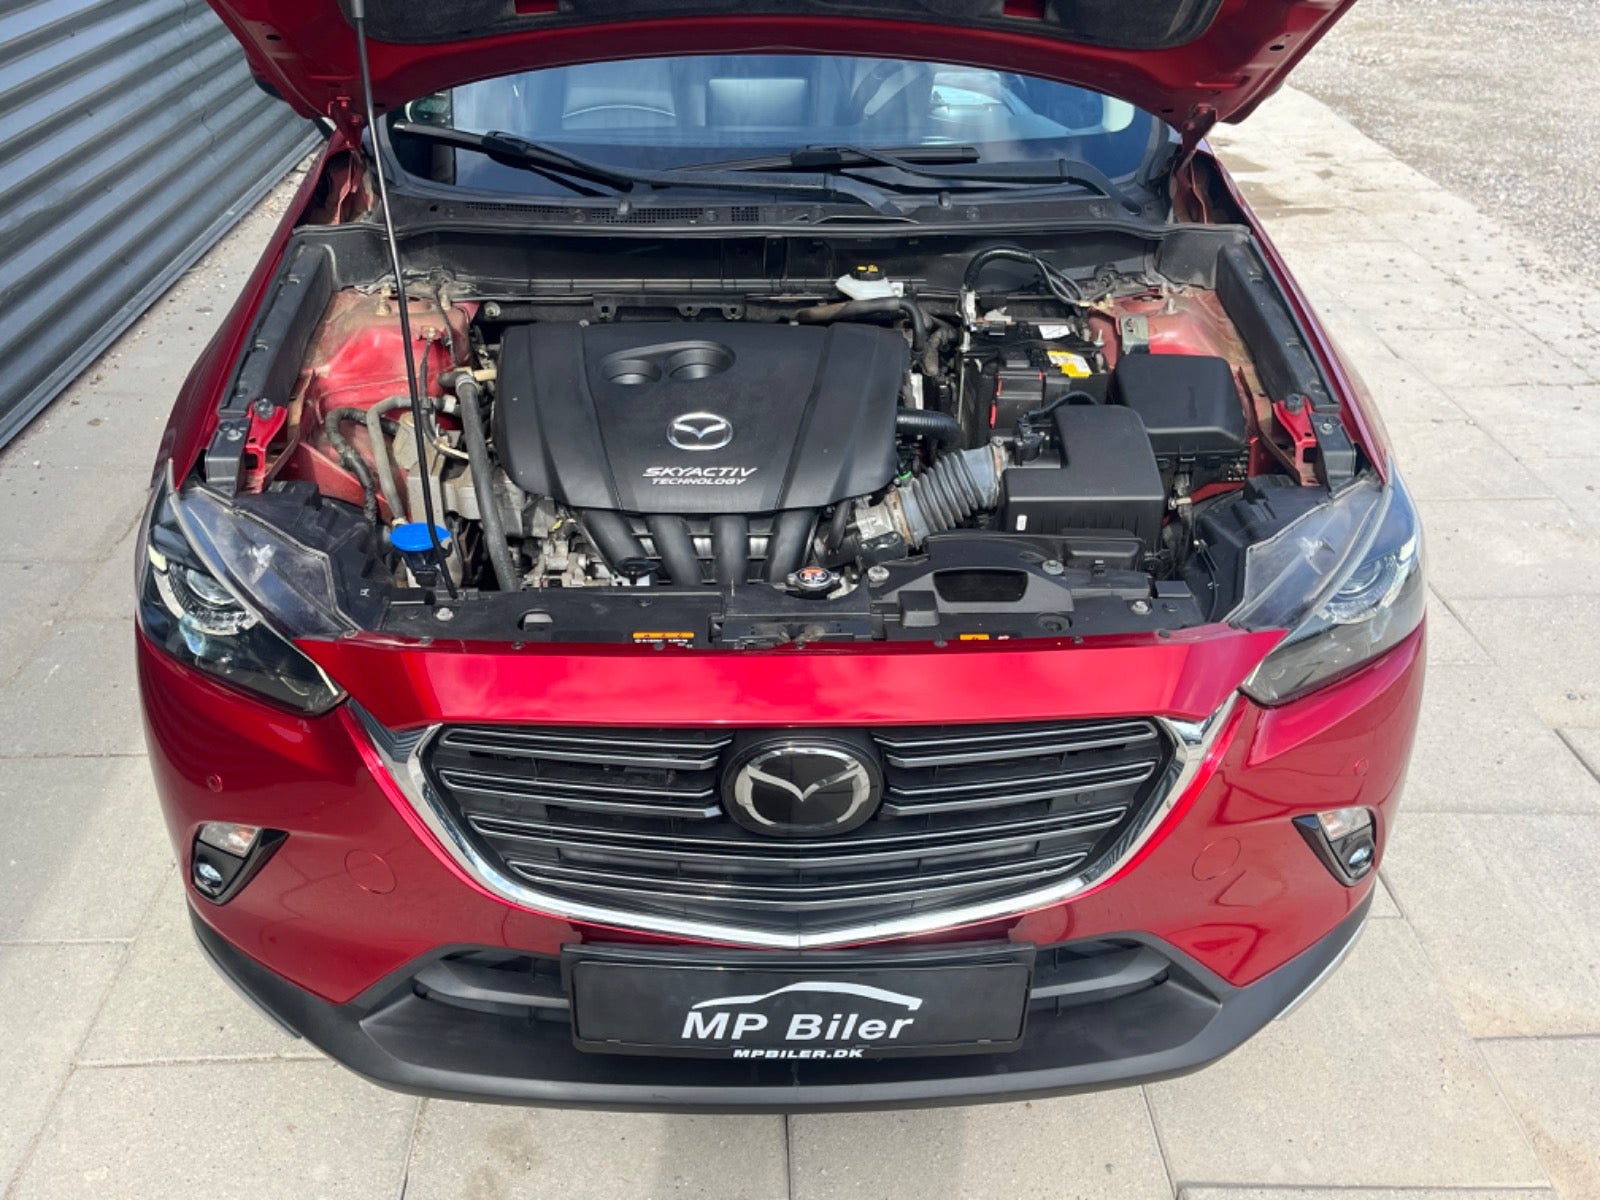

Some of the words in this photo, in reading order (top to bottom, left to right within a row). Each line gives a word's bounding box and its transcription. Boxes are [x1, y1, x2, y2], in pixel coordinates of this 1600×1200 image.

[642, 467, 757, 477] SKYACTIV
[651, 477, 747, 485] TECHNOLOGY
[681, 1011, 768, 1040] MP
[785, 1013, 914, 1040] Biler
[732, 1048, 863, 1059] MPBILER.DK
